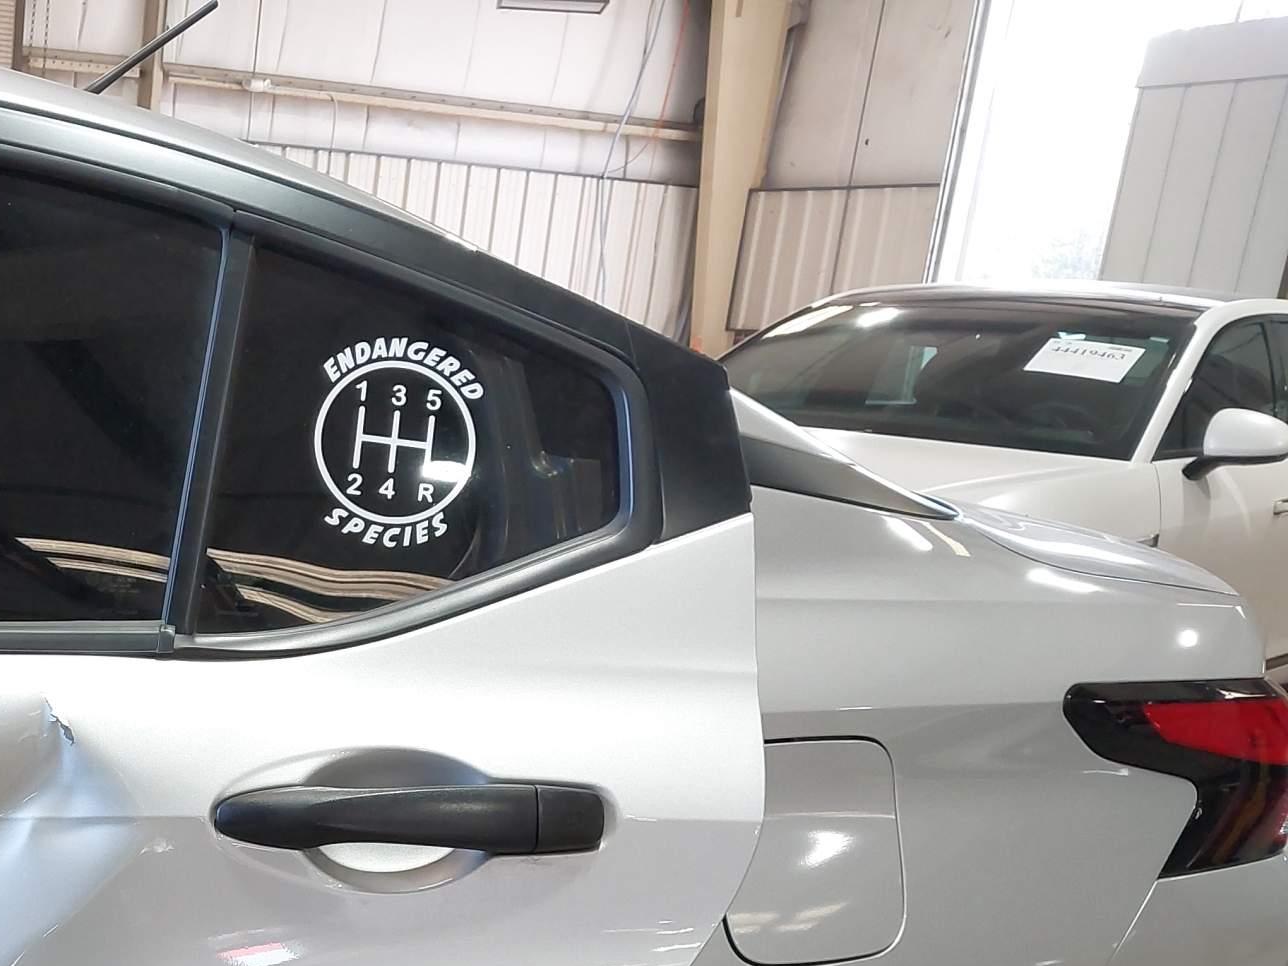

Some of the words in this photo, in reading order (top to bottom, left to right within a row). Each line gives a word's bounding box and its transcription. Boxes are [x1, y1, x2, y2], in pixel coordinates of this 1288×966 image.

[323, 337, 484, 400] ENDANGERED
[356, 380, 368, 402] 1
[391, 384, 407, 406] 3
[426, 389, 442, 410] 5
[346, 473, 363, 496] 2
[378, 478, 396, 500] 4
[417, 483, 435, 503] R
[324, 507, 448, 548] SPECIES
